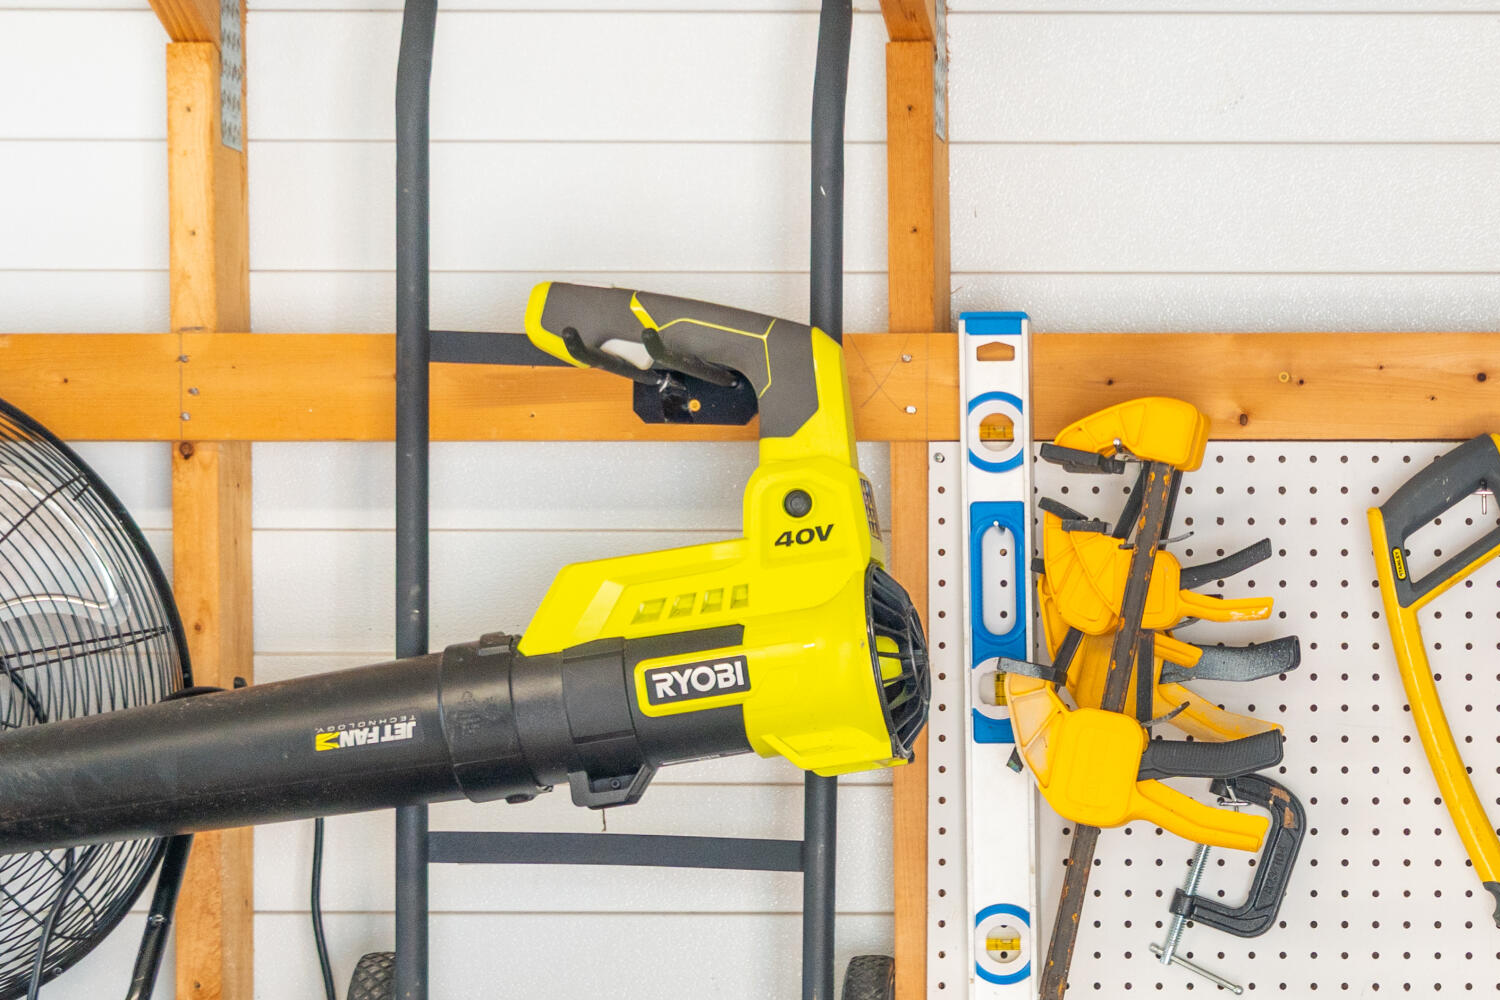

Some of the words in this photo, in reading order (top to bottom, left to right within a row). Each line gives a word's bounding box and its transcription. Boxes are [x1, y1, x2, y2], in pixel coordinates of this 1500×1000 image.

[775, 524, 835, 547] 40V
[652, 660, 745, 698] RYOBI
[339, 726, 379, 748] FAN
[381, 721, 416, 742] JET
